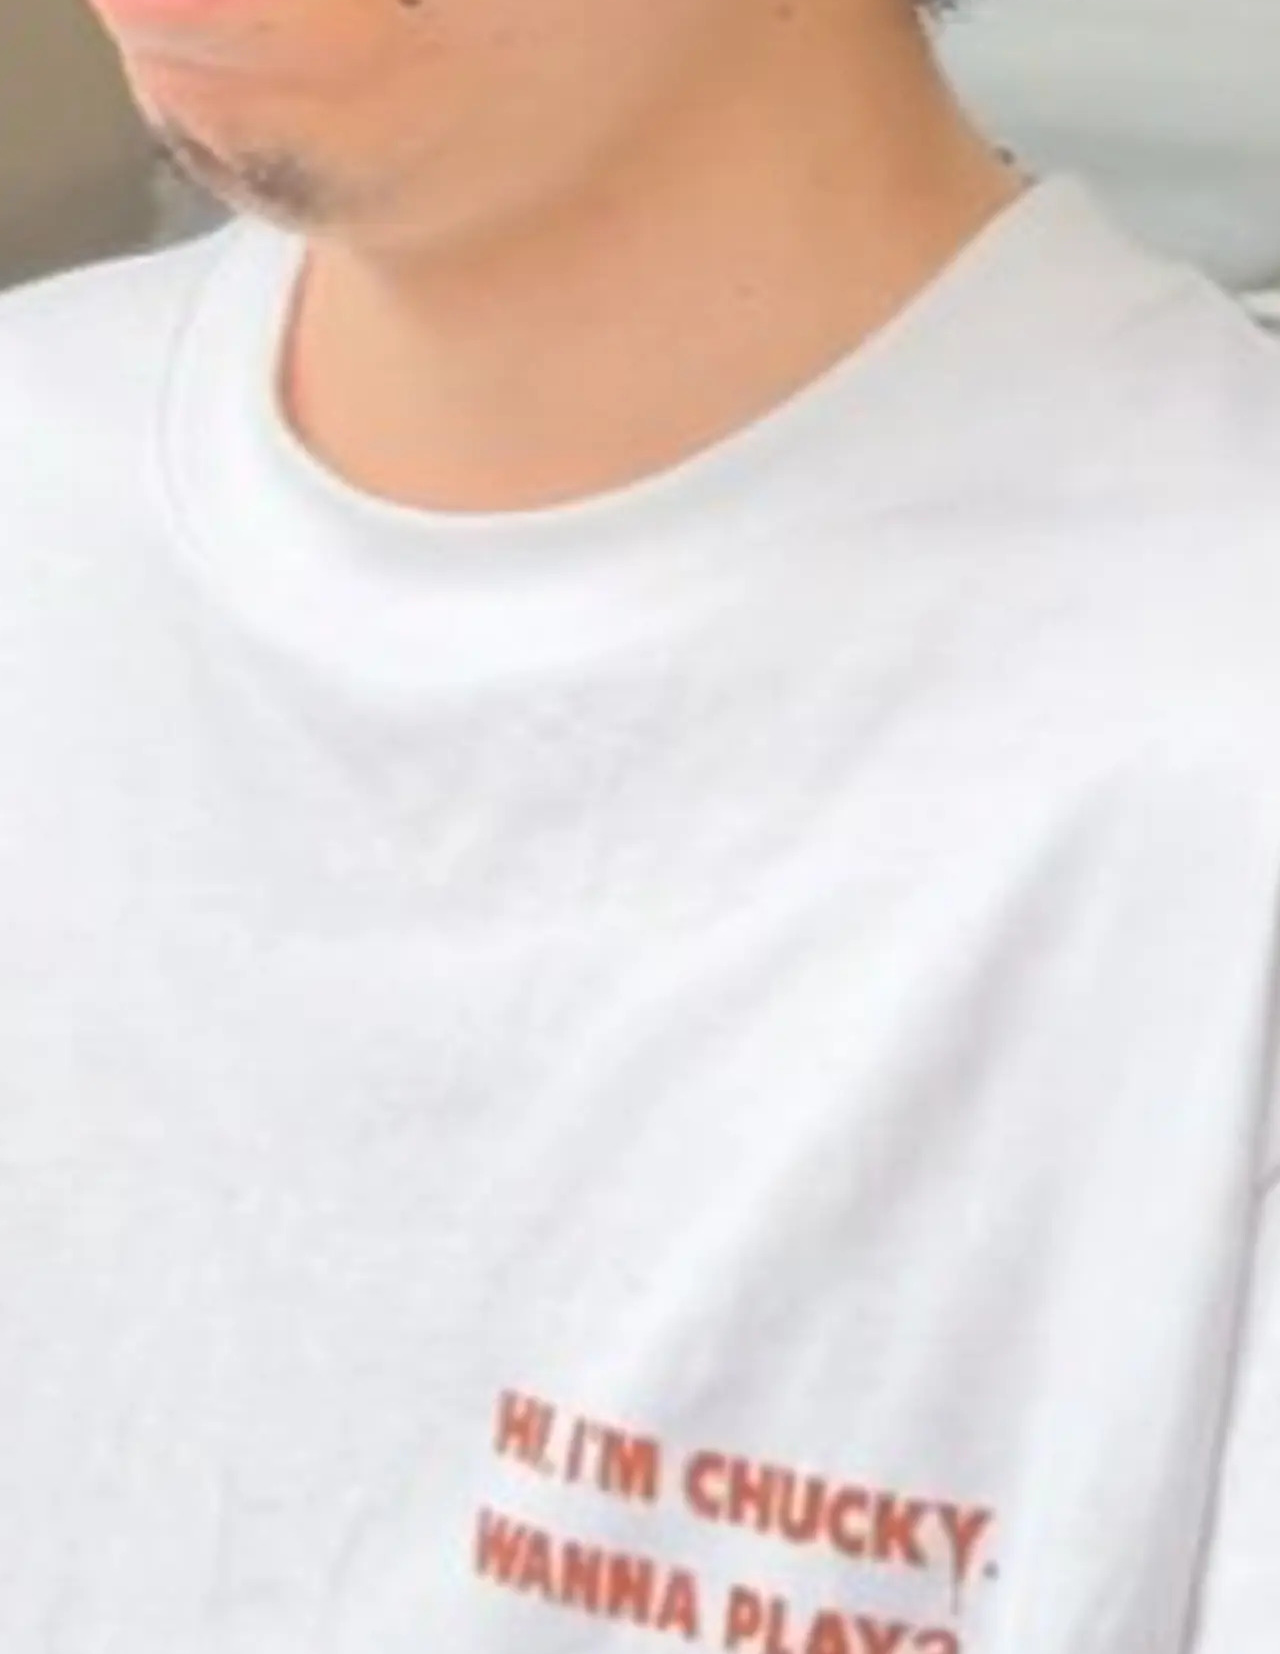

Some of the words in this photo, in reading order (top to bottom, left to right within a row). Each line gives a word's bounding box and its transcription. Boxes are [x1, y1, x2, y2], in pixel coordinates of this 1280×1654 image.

[474, 1506, 699, 1641] WANNA
[567, 1414, 661, 1505] I'M
[683, 1449, 998, 1598] CHUCKY.
